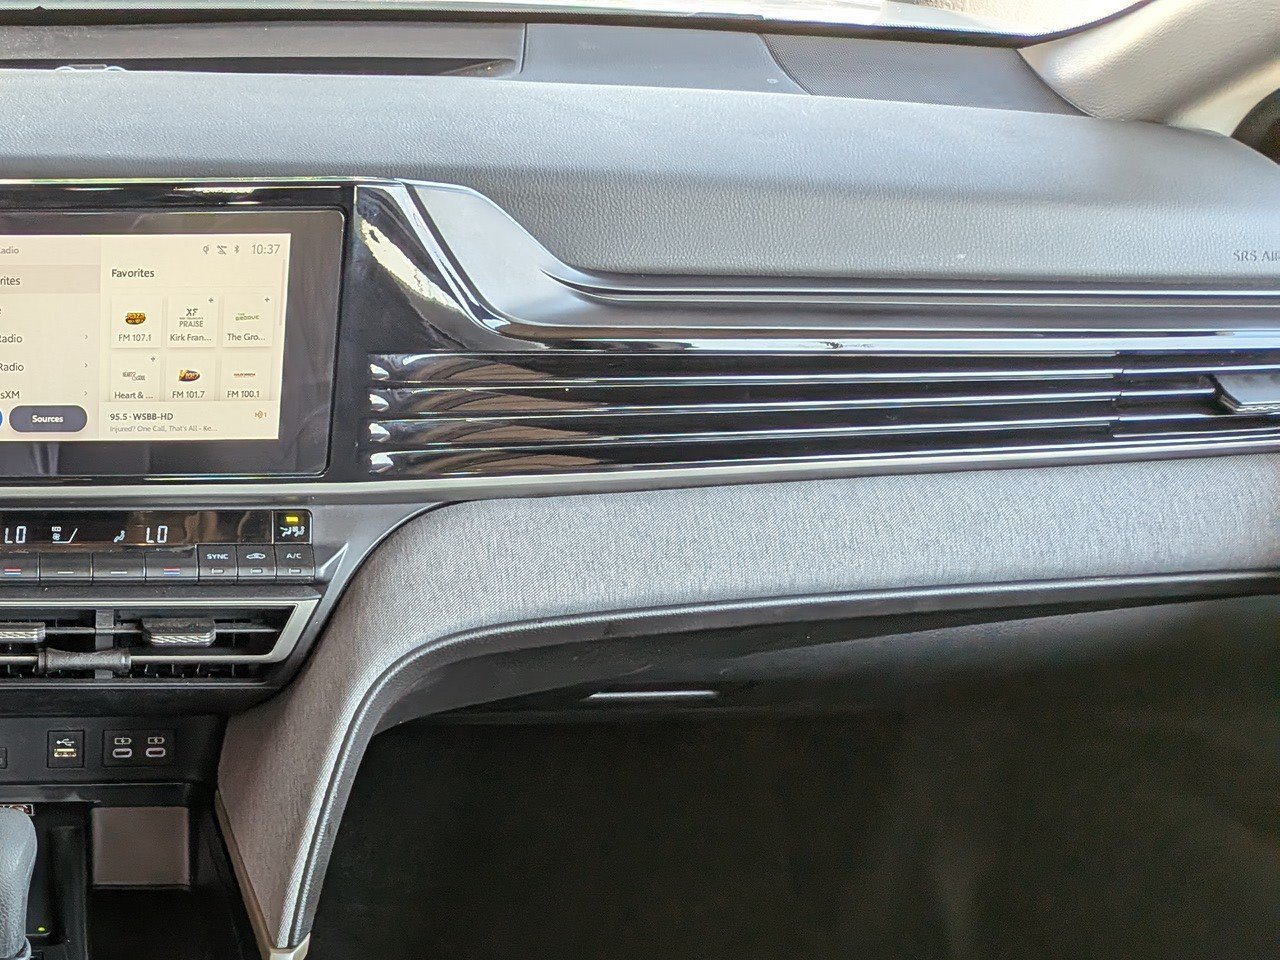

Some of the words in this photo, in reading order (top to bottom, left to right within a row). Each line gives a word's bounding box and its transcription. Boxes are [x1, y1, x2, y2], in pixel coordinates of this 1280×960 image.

[251, 244, 281, 255] 10:37
[1233, 250, 1257, 261] SRS
[111, 268, 155, 278] Favorites
[179, 320, 204, 328] PRAISE
[118, 334, 131, 342] FM
[132, 333, 152, 342] 107.1
[170, 333, 186, 342] Kirk
[187, 333, 212, 342] Fran...
[227, 333, 242, 341] The
[243, 333, 266, 341] Gro...
[114, 391, 136, 399] Heart
[172, 391, 185, 399] FM
[186, 391, 205, 399] 101.7
[227, 390, 239, 398] FM
[241, 390, 260, 398] 100.1
[32, 415, 64, 424] Sources
[110, 413, 128, 421] 95.5
[110, 425, 137, 434] Injured?
[152, 425, 167, 433] Call,
[5, 526, 27, 544] LO
[145, 525, 169, 544] LO
